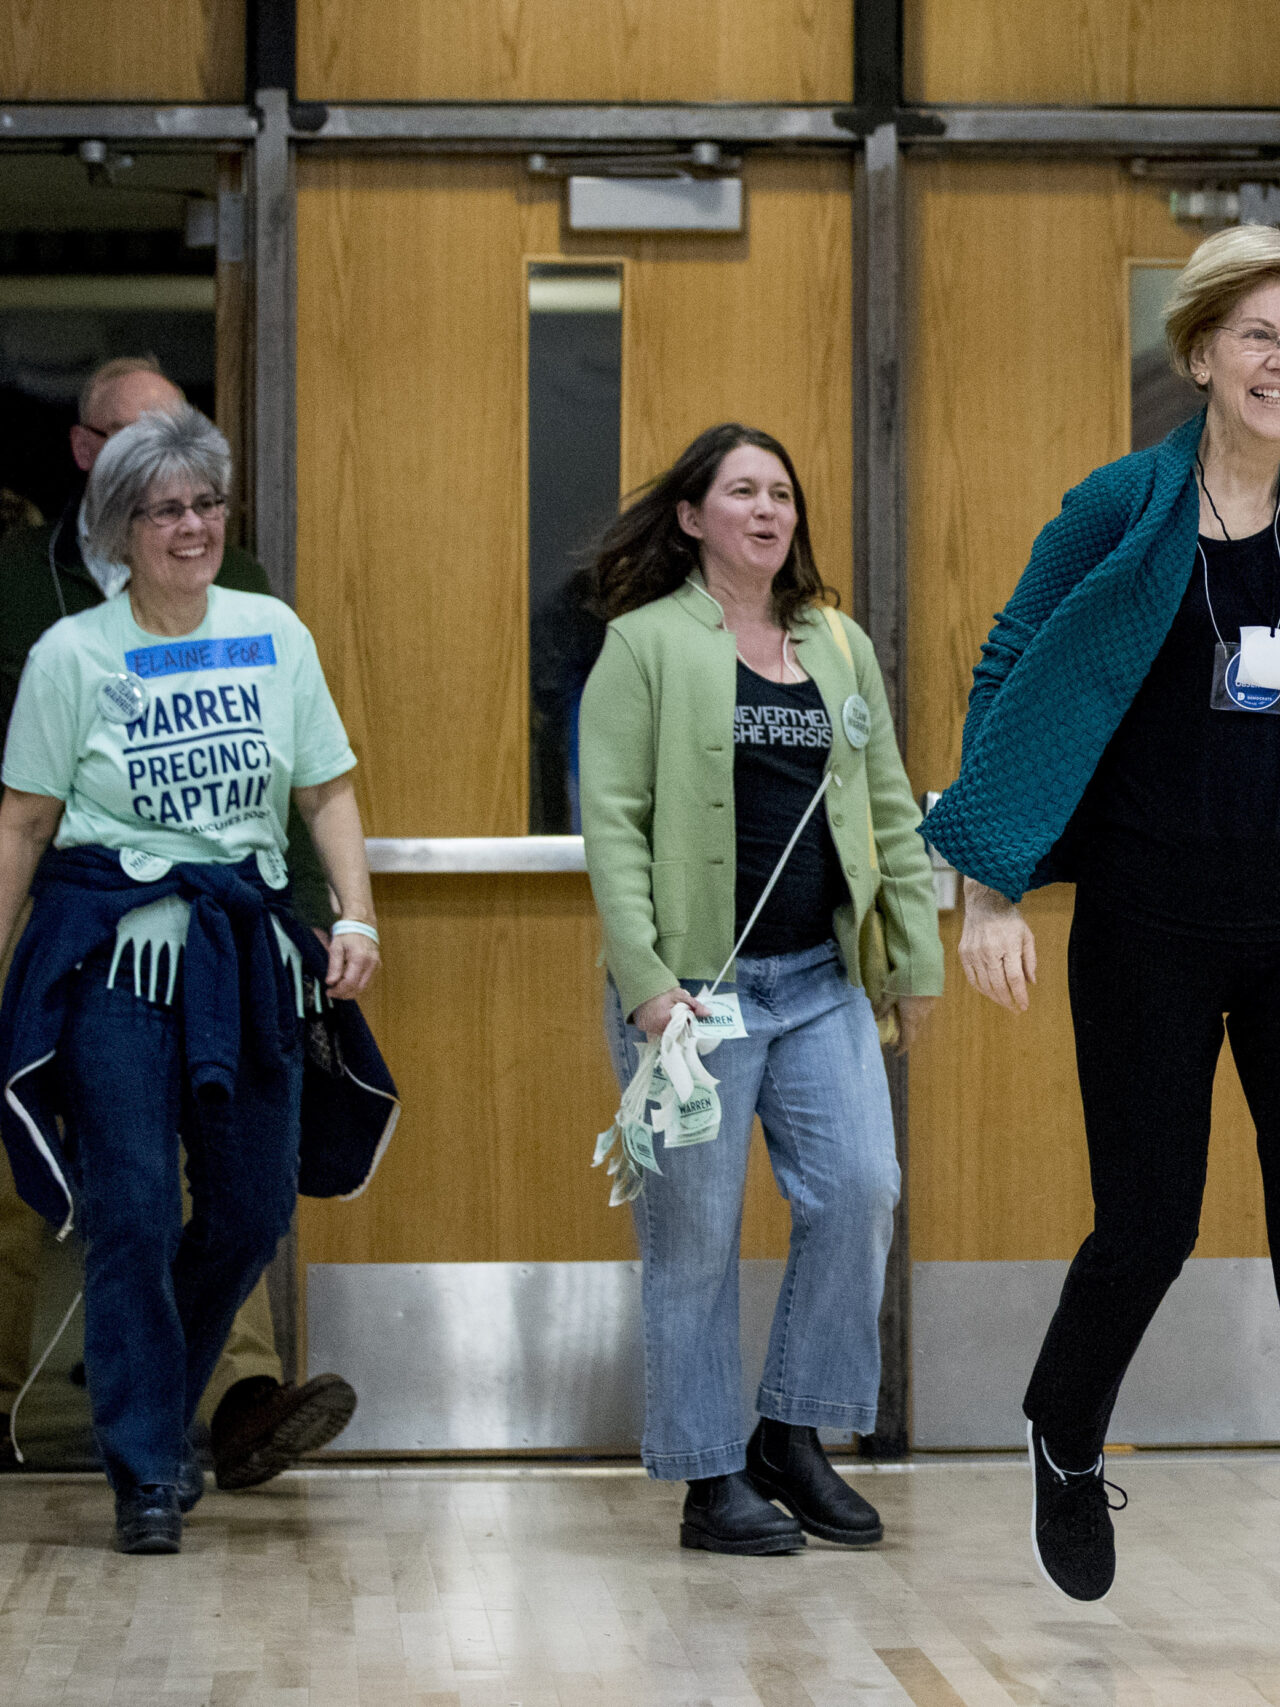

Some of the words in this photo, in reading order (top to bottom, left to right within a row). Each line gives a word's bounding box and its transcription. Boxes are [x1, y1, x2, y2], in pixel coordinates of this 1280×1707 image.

[133, 644, 216, 674] ELAINE
[226, 640, 262, 665] FOR
[124, 683, 262, 741] WARREN
[734, 725, 767, 744] SHE
[768, 726, 831, 748] PERSIS
[128, 739, 271, 790] PRECINCT
[132, 773, 272, 825] CAPTAIN
[697, 1015, 733, 1025] WARREN
[679, 1098, 711, 1114] WARREN
